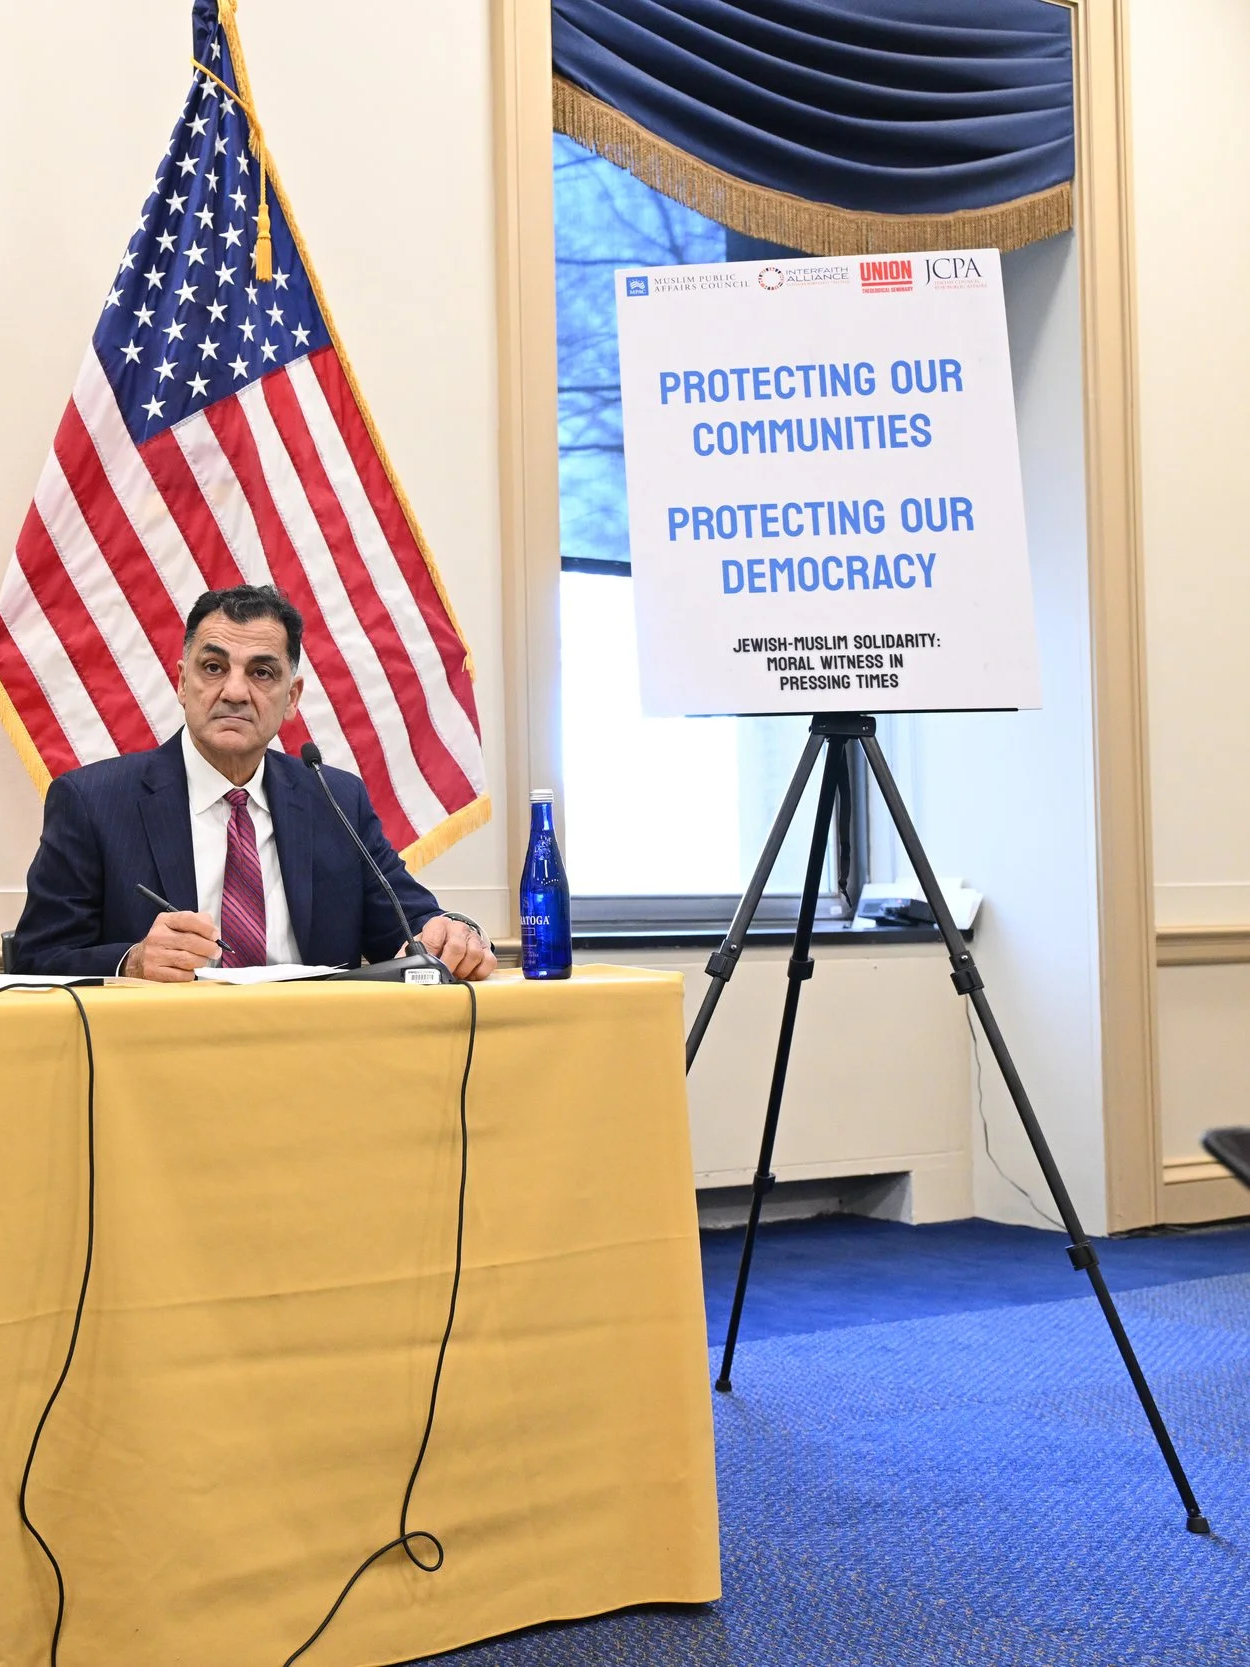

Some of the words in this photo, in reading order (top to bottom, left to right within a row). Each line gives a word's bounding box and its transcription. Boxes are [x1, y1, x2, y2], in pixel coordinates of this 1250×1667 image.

[654, 276, 696, 285] MUSLIM
[699, 273, 736, 282] PUBLIC
[786, 266, 849, 275] INTERFAITH
[787, 273, 849, 282] ALLIANCE
[859, 260, 913, 281] UNION
[925, 257, 984, 286] JCPA
[654, 283, 698, 293] AFFAIRS
[700, 280, 751, 290] COUNCIL
[660, 362, 876, 405] PROTECTING
[890, 358, 963, 394] OUR
[693, 413, 932, 457] COMMUNITIES
[668, 498, 886, 542] PROTECTING
[901, 497, 975, 533] OUR
[722, 553, 937, 595] DEMOCRACY
[733, 636, 848, 653] JEWISH-MUSLIM
[853, 633, 941, 649] SOLIDARITY:
[766, 656, 815, 672] MORAL
[819, 654, 883, 670] WITNESS
[889, 653, 904, 668] IN
[779, 674, 851, 691] PRESSING
[855, 673, 899, 689] TIMES
